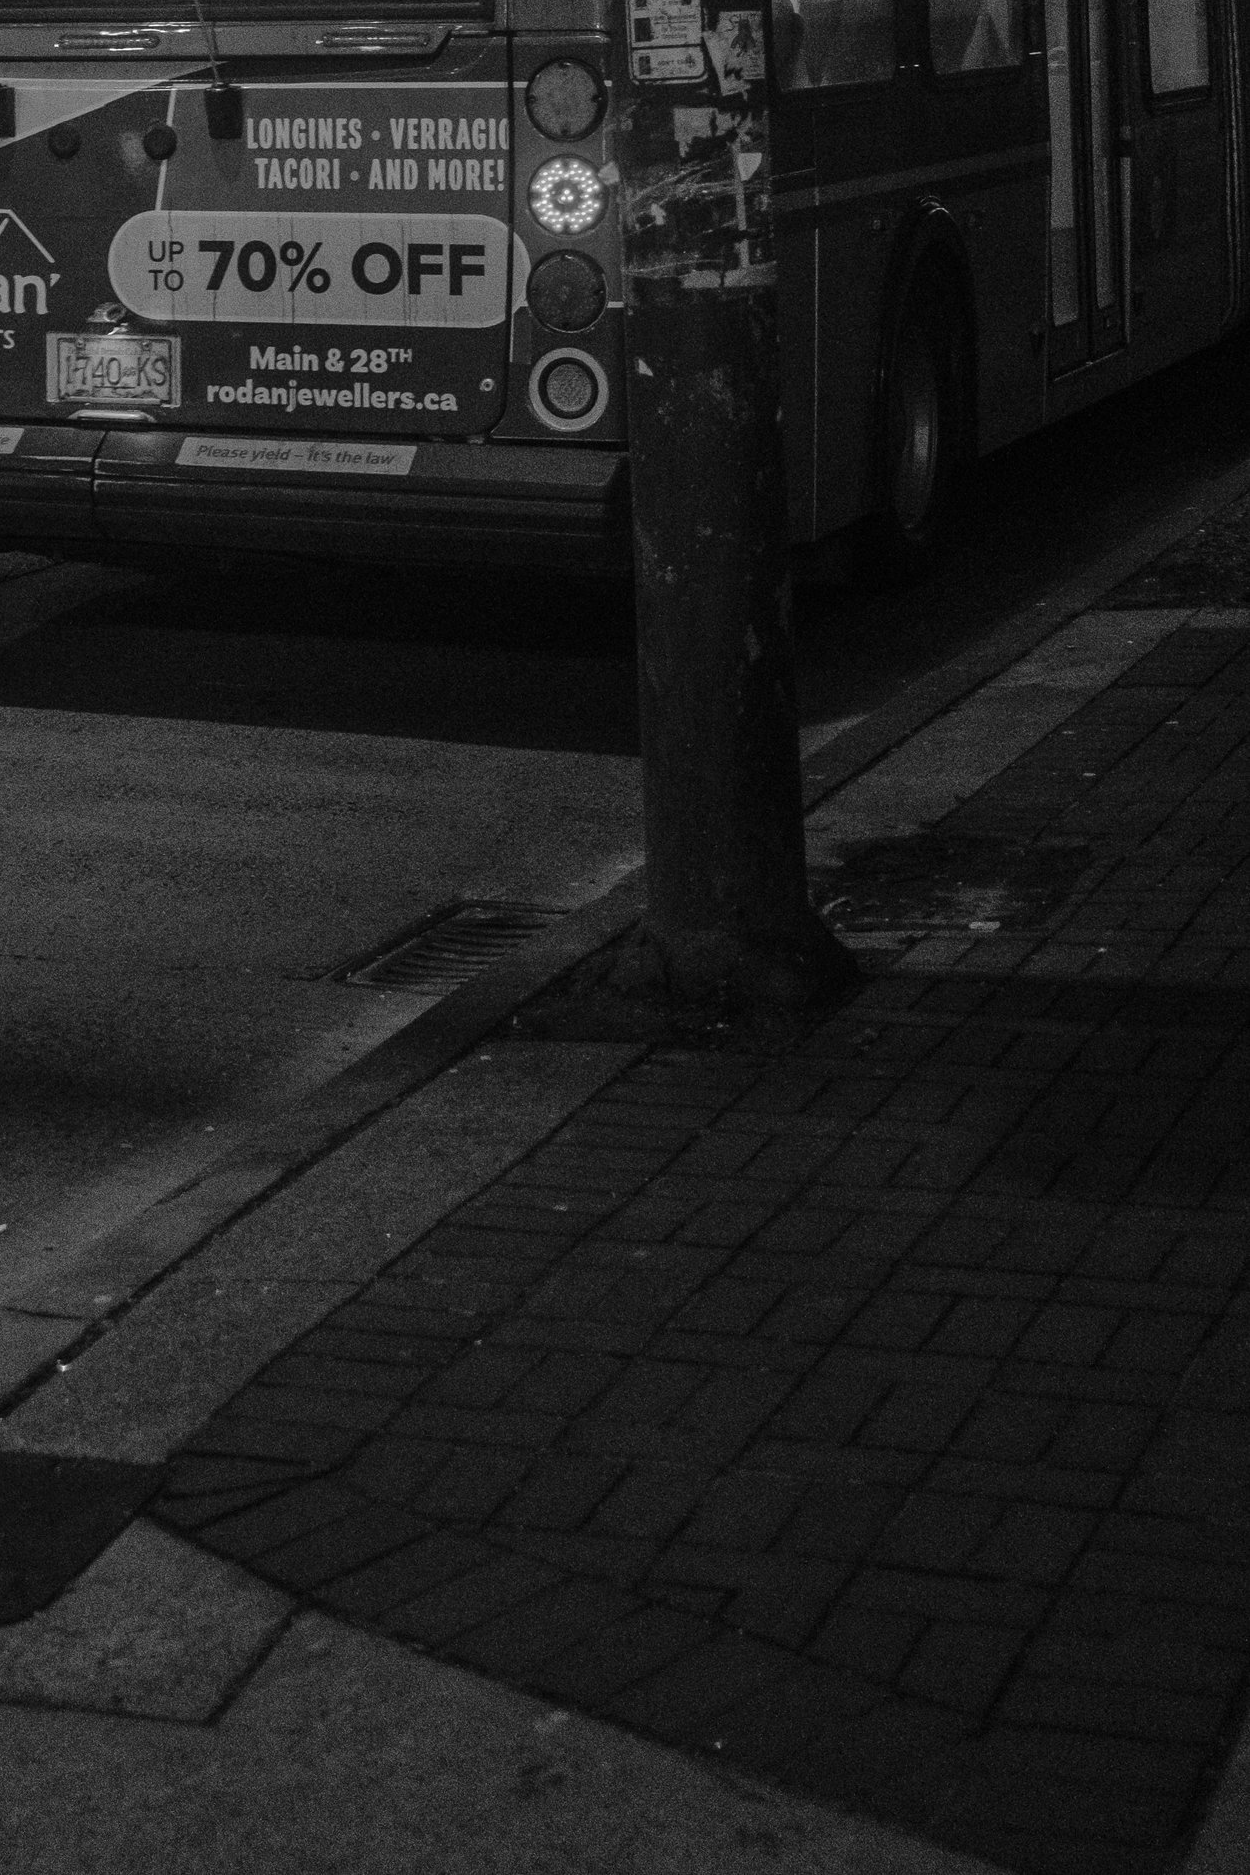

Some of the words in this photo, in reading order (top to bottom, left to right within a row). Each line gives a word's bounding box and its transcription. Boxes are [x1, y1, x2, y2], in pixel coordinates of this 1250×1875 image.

[246, 117, 362, 150] LONGINES
[254, 157, 341, 189] TACORI
[368, 158, 419, 191] AND
[427, 158, 505, 192] MORE!
[148, 239, 184, 263] UP
[147, 269, 184, 292] TO
[197, 238, 332, 294] 70%
[351, 241, 486, 296] OFF
[249, 344, 319, 373] Main
[324, 347, 346, 373] &
[350, 347, 414, 374] 28TH
[205, 379, 459, 413] rodanjewellers.ca
[196, 444, 249, 460] Please
[249, 446, 291, 462] yield
[306, 448, 332, 463] it's
[334, 447, 363, 464] the
[365, 450, 397, 465] law
